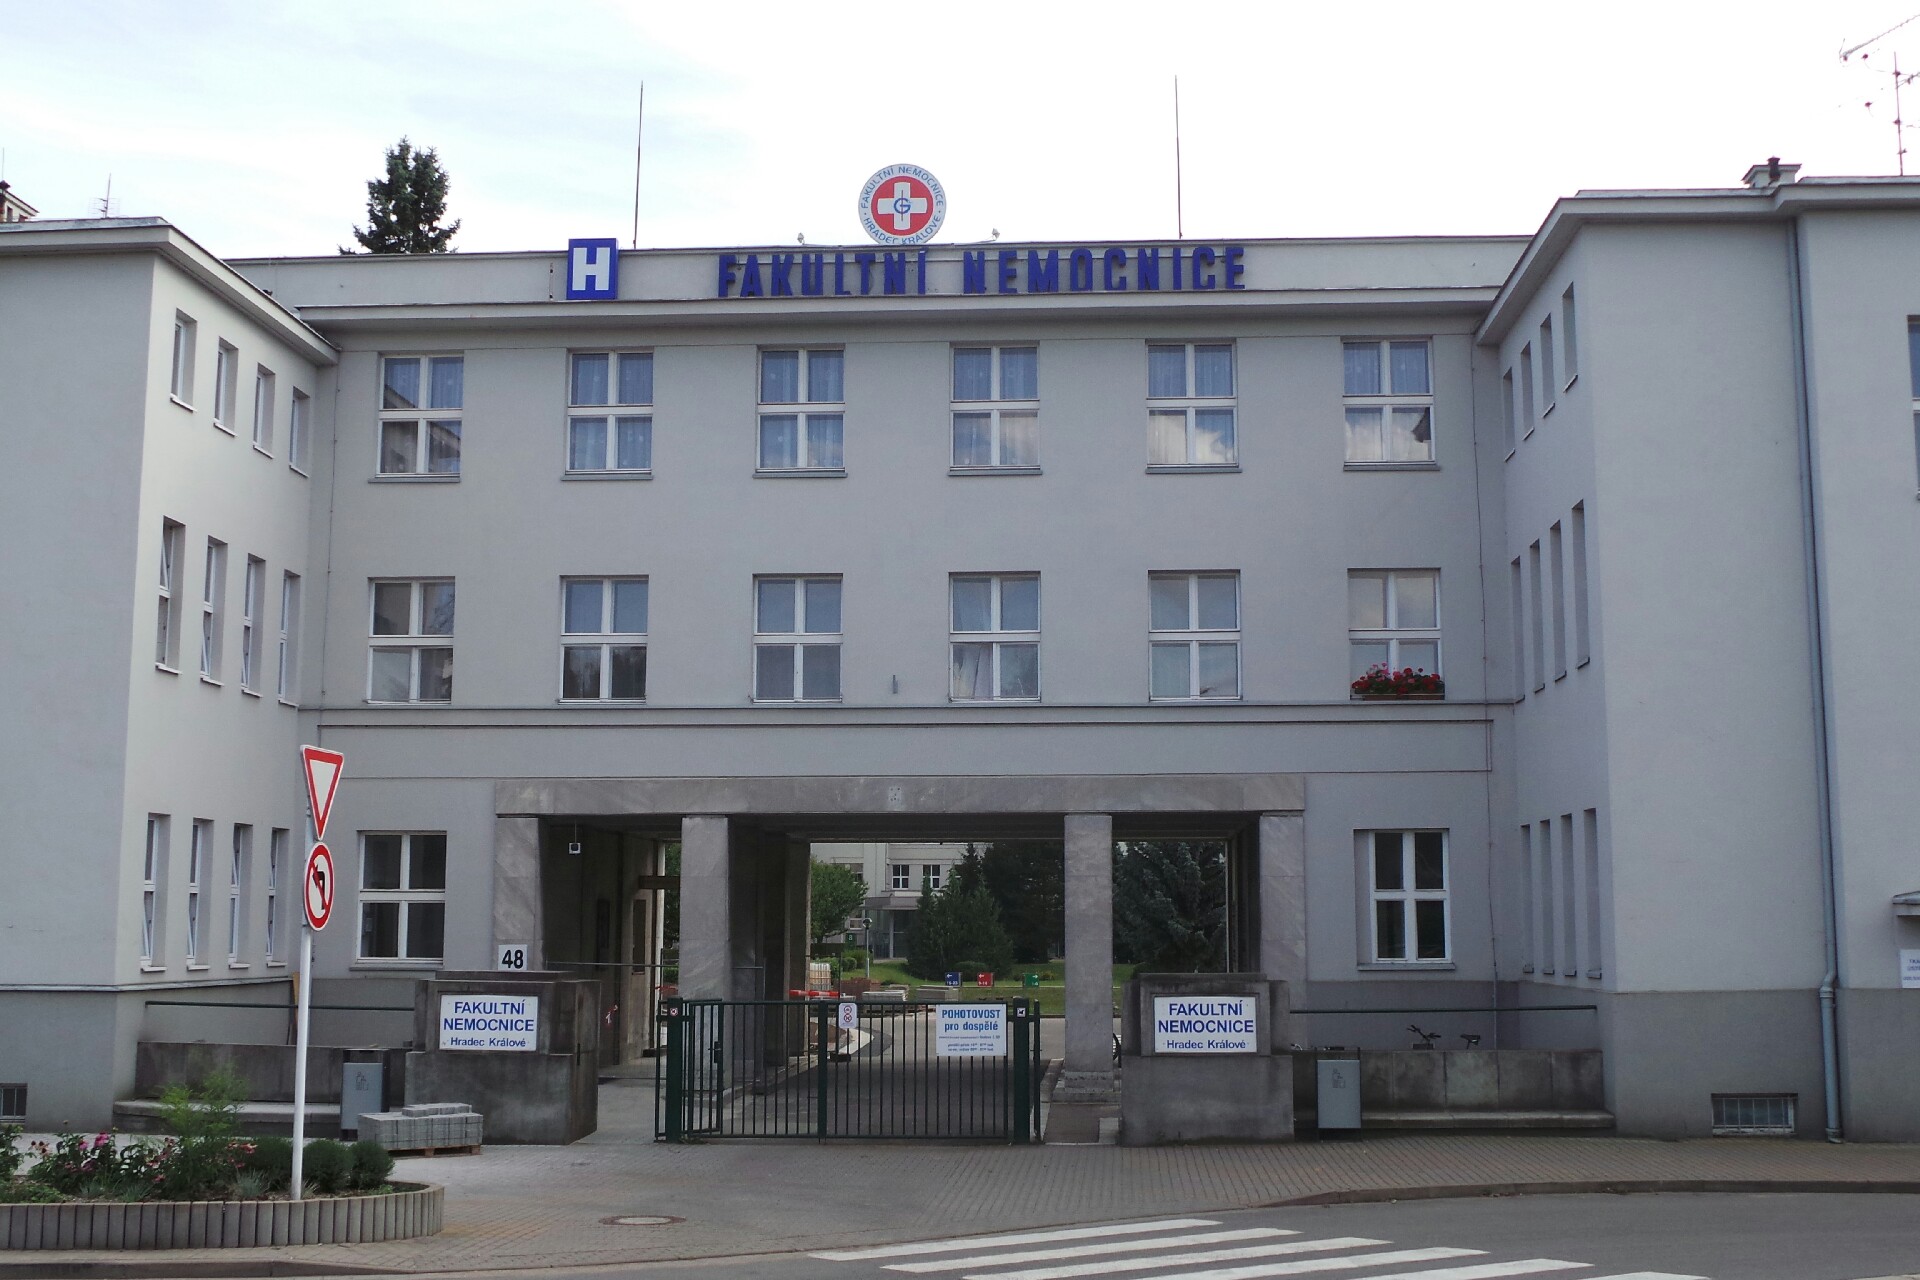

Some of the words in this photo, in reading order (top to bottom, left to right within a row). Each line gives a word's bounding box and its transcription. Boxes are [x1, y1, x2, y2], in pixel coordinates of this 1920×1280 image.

[898, 166, 944, 207] NEMOCNICE
[572, 247, 611, 291] H
[963, 246, 1246, 295] NEMOCNICE
[501, 949, 524, 969] 48
[454, 999, 526, 1015] FAKULTNÍ
[941, 1009, 1001, 1019] POHOTOVOST
[1169, 1000, 1243, 1016] FAKULTNÍ
[443, 1018, 535, 1032] NEMOCNICE
[944, 1022, 959, 1032] pro
[962, 1020, 999, 1032] dospělé
[1158, 1020, 1254, 1033] NEMOCNICE
[450, 1037, 485, 1047] Hradec
[488, 1037, 527, 1047] Králové
[1166, 1039, 1204, 1049] Hradec
[1207, 1039, 1246, 1049] Králové
